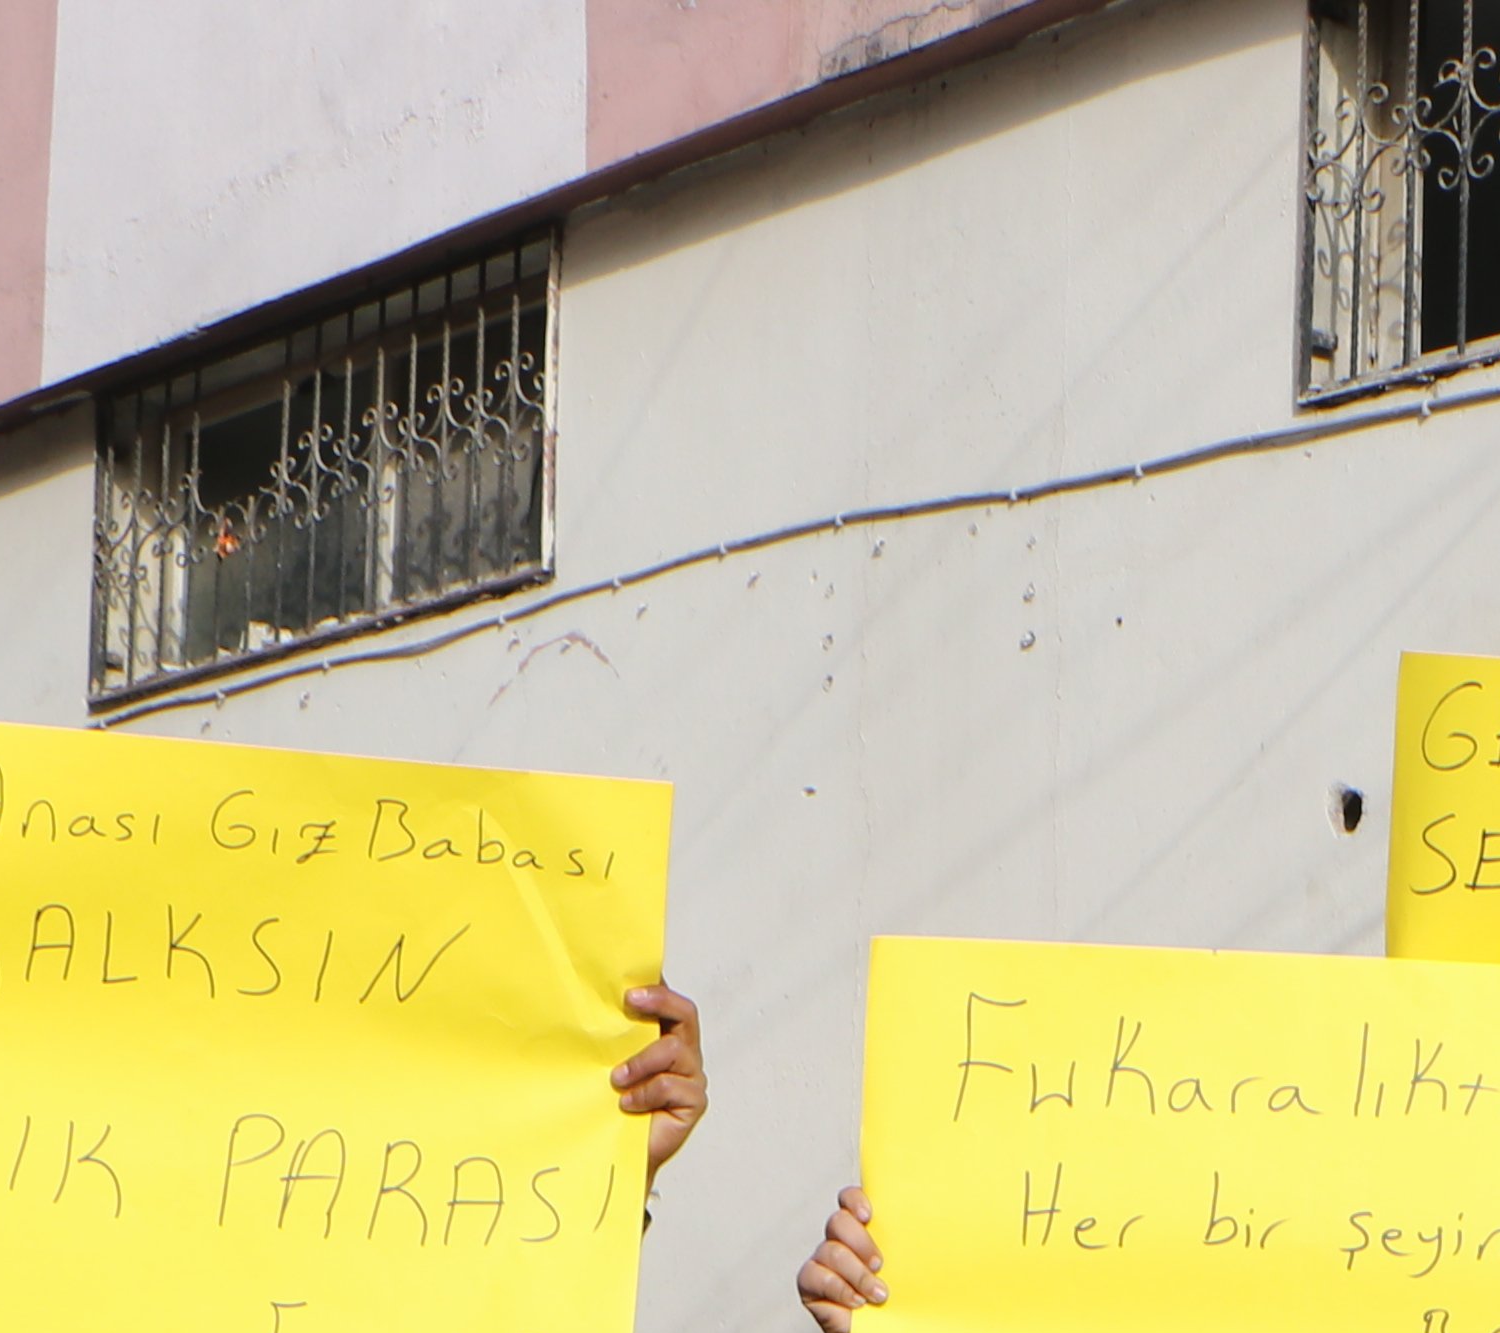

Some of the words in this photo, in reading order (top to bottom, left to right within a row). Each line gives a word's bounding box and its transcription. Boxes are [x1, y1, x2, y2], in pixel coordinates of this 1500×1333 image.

[217, 1112, 617, 1248] PARASI
[1021, 1161, 1145, 1252] Her
[1202, 1169, 1285, 1251] bir
